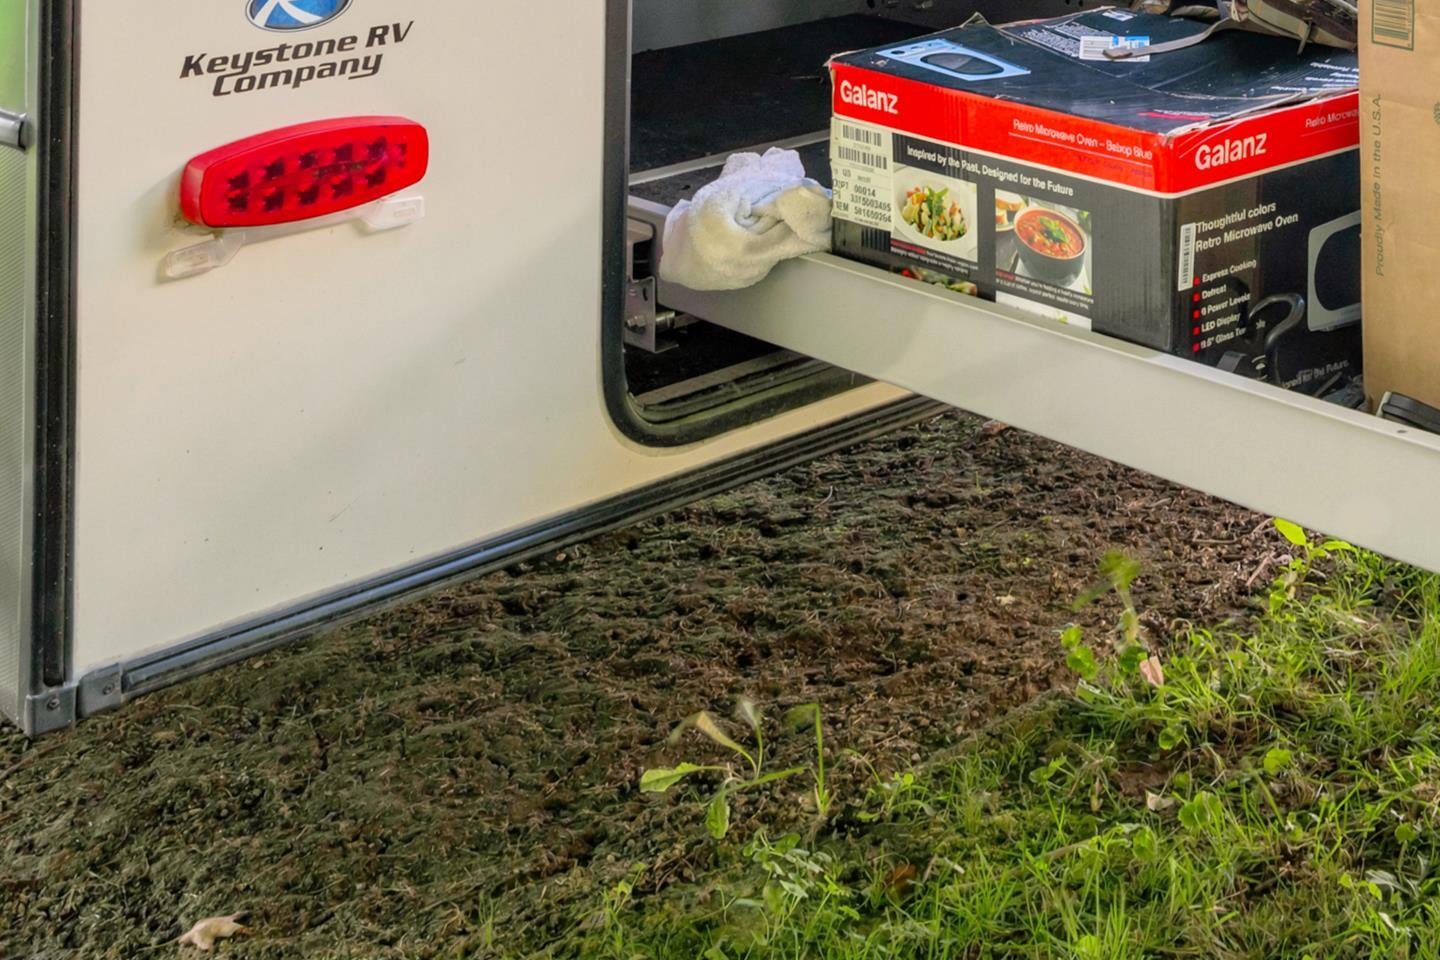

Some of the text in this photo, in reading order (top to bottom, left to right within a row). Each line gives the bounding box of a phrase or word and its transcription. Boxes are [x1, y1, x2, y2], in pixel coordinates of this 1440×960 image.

[179, 20, 414, 79] Keystone RV
[212, 53, 384, 97] Company
[840, 79, 899, 115] Galanz
[1035, 123, 1075, 143] Microwave
[1076, 133, 1098, 147] Oven
[1195, 132, 1268, 171] Galanz
[907, 145, 937, 163] Inspired
[937, 153, 947, 166] by
[947, 156, 960, 168] the
[982, 166, 1018, 184] Designed
[1020, 173, 1032, 186] for
[1032, 176, 1046, 190] the
[1047, 180, 1074, 197] Future
[1372, 94, 1386, 277] Proudly Made in the U.S.A.
[1195, 202, 1277, 234] Thoughtful colors
[1195, 213, 1299, 253] Retro Microwave Oven
